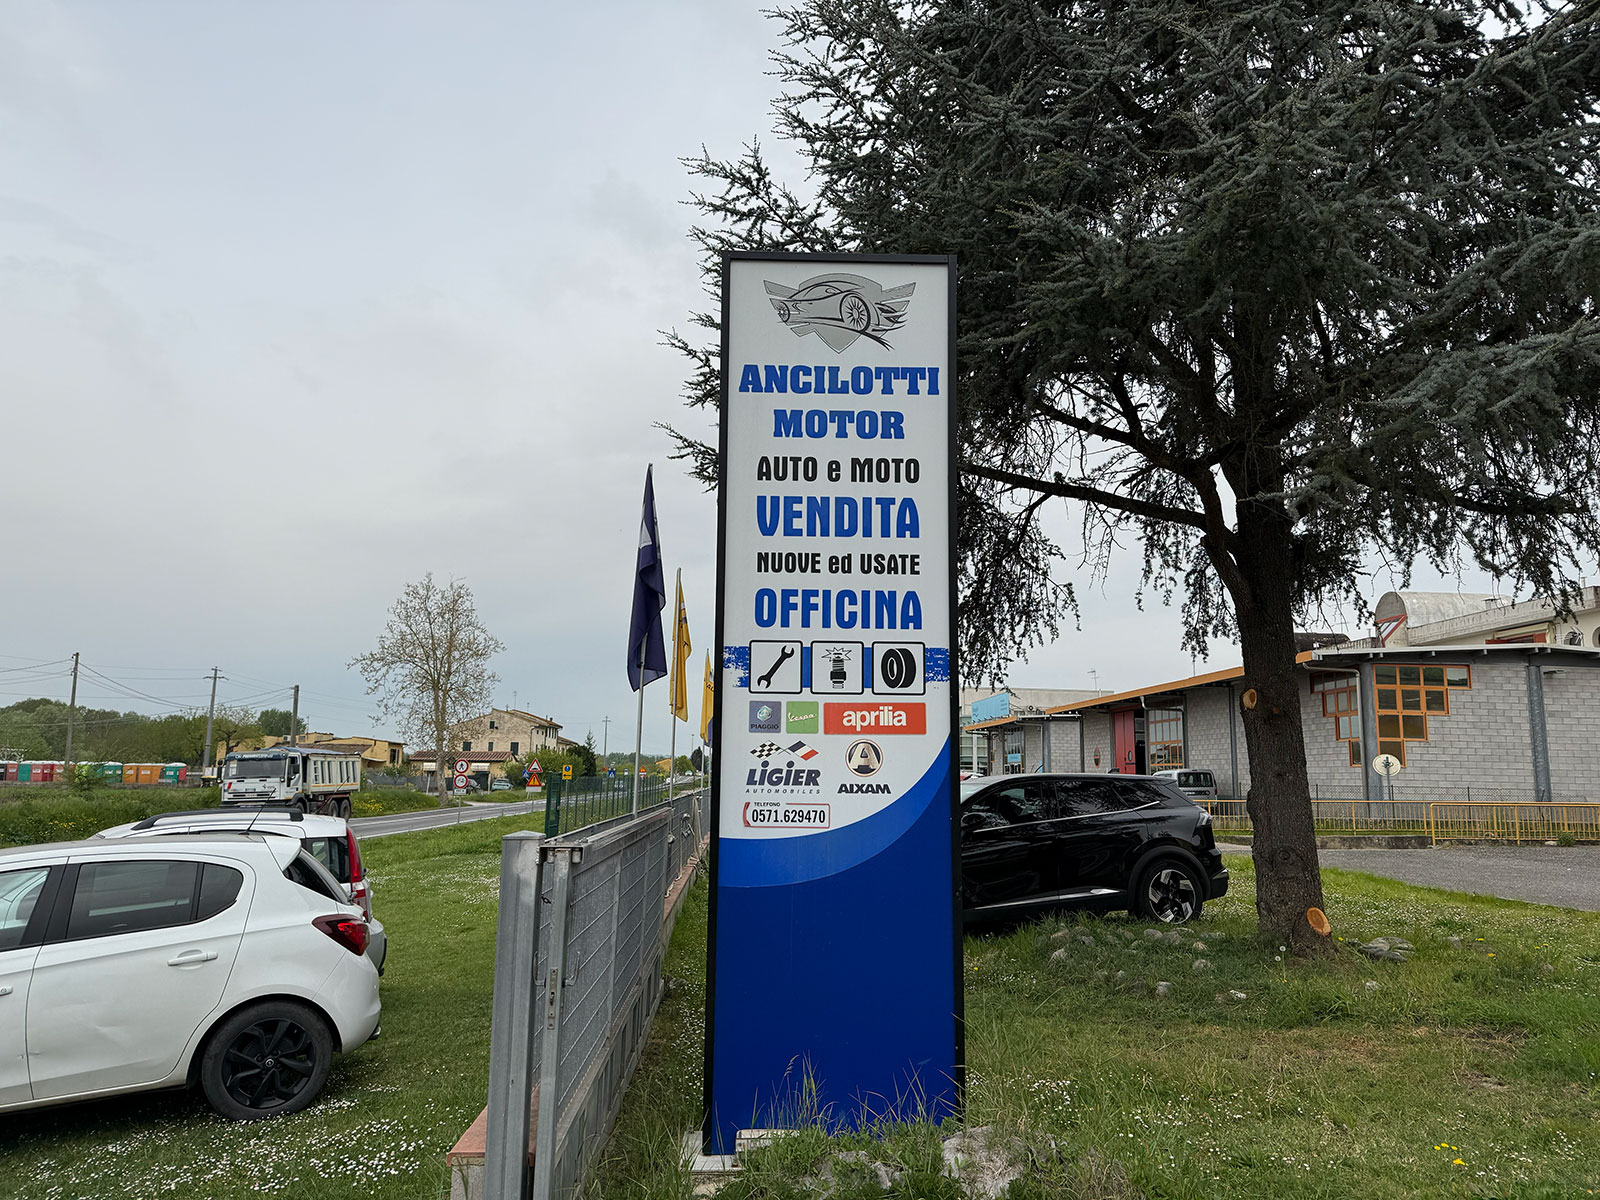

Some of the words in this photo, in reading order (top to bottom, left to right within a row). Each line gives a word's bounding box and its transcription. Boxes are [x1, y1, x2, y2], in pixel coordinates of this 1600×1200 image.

[738, 364, 940, 396] ANCILOTTI
[773, 409, 905, 440] MOTOR
[756, 455, 818, 482] AUTO
[827, 460, 841, 482] e
[850, 457, 920, 484] MOTO
[756, 495, 920, 539] VENDITA
[756, 552, 821, 574] NUOVE
[828, 554, 852, 574] ed
[860, 553, 921, 575] USATE
[754, 587, 923, 630] OFFICINA
[842, 706, 907, 732] aprilia
[837, 783, 892, 794] AIXAM
[751, 808, 826, 824] 0571.629470
